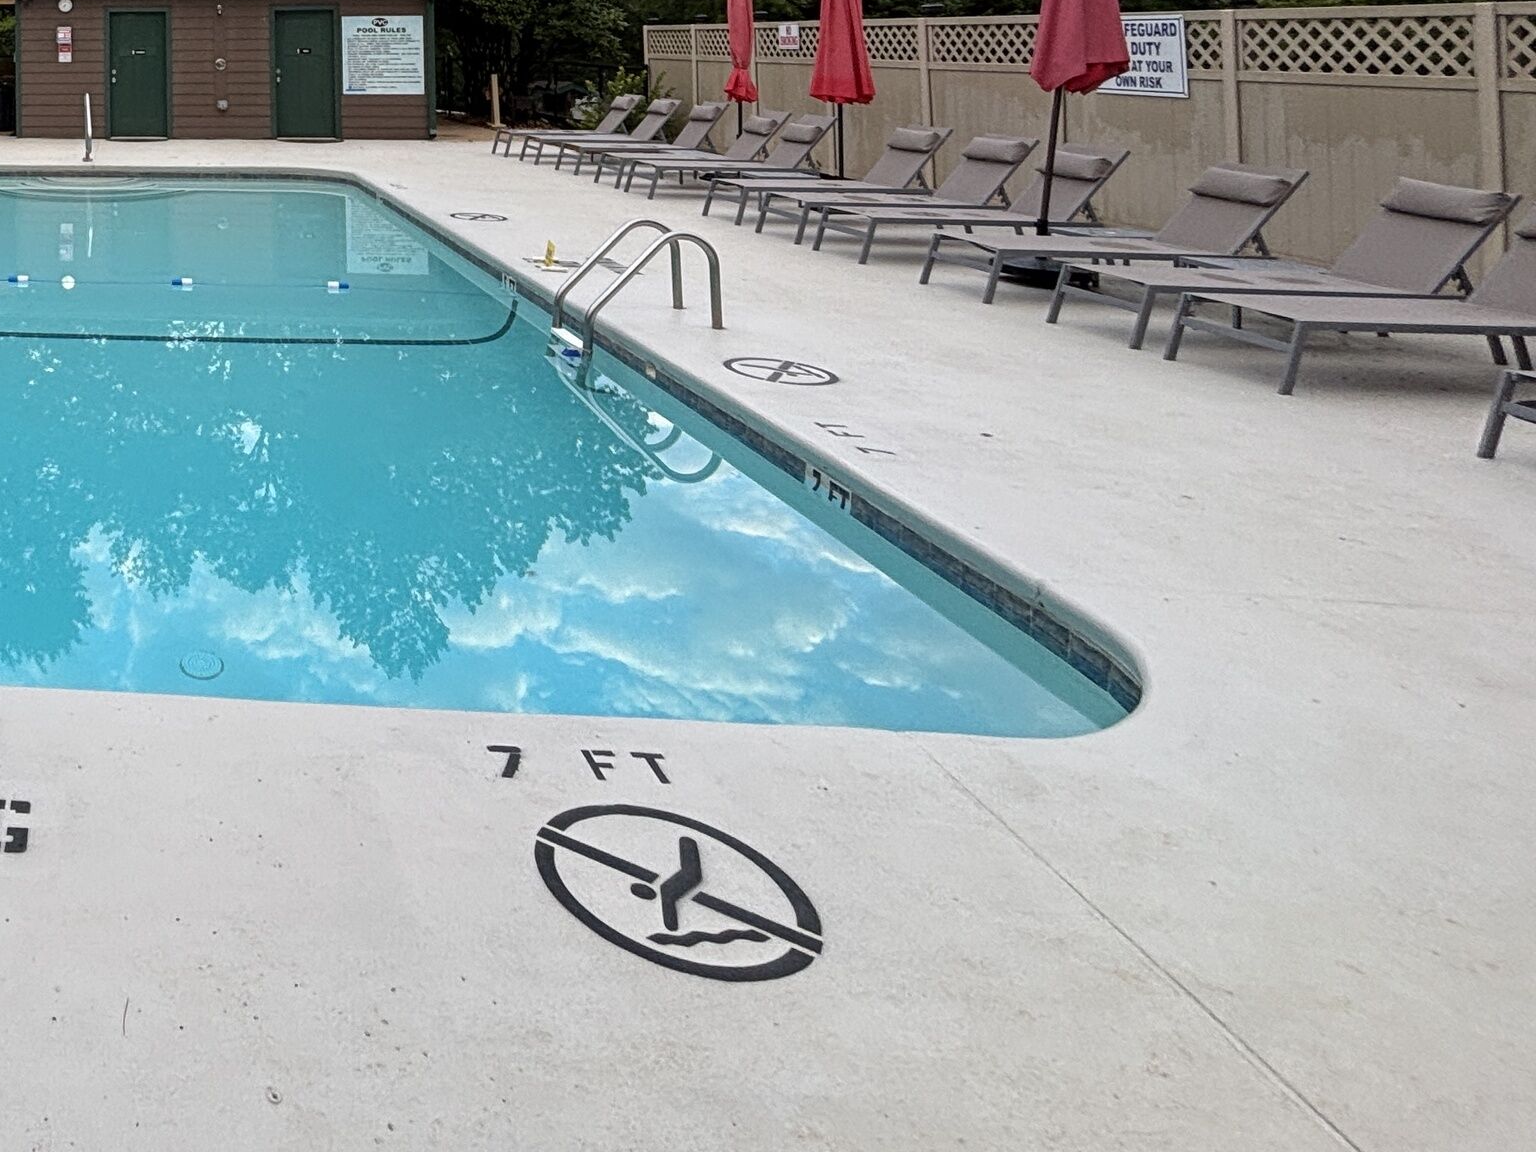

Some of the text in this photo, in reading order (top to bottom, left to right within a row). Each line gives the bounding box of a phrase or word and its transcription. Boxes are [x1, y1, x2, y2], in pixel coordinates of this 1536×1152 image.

[1124, 23, 1177, 37] FEGUARD
[1131, 42, 1161, 56] DUTY
[1131, 60, 1173, 73] AT YOUR
[1115, 75, 1163, 88] OWN RISK
[812, 468, 851, 510] 7 FT
[486, 744, 672, 784] 7 FT
